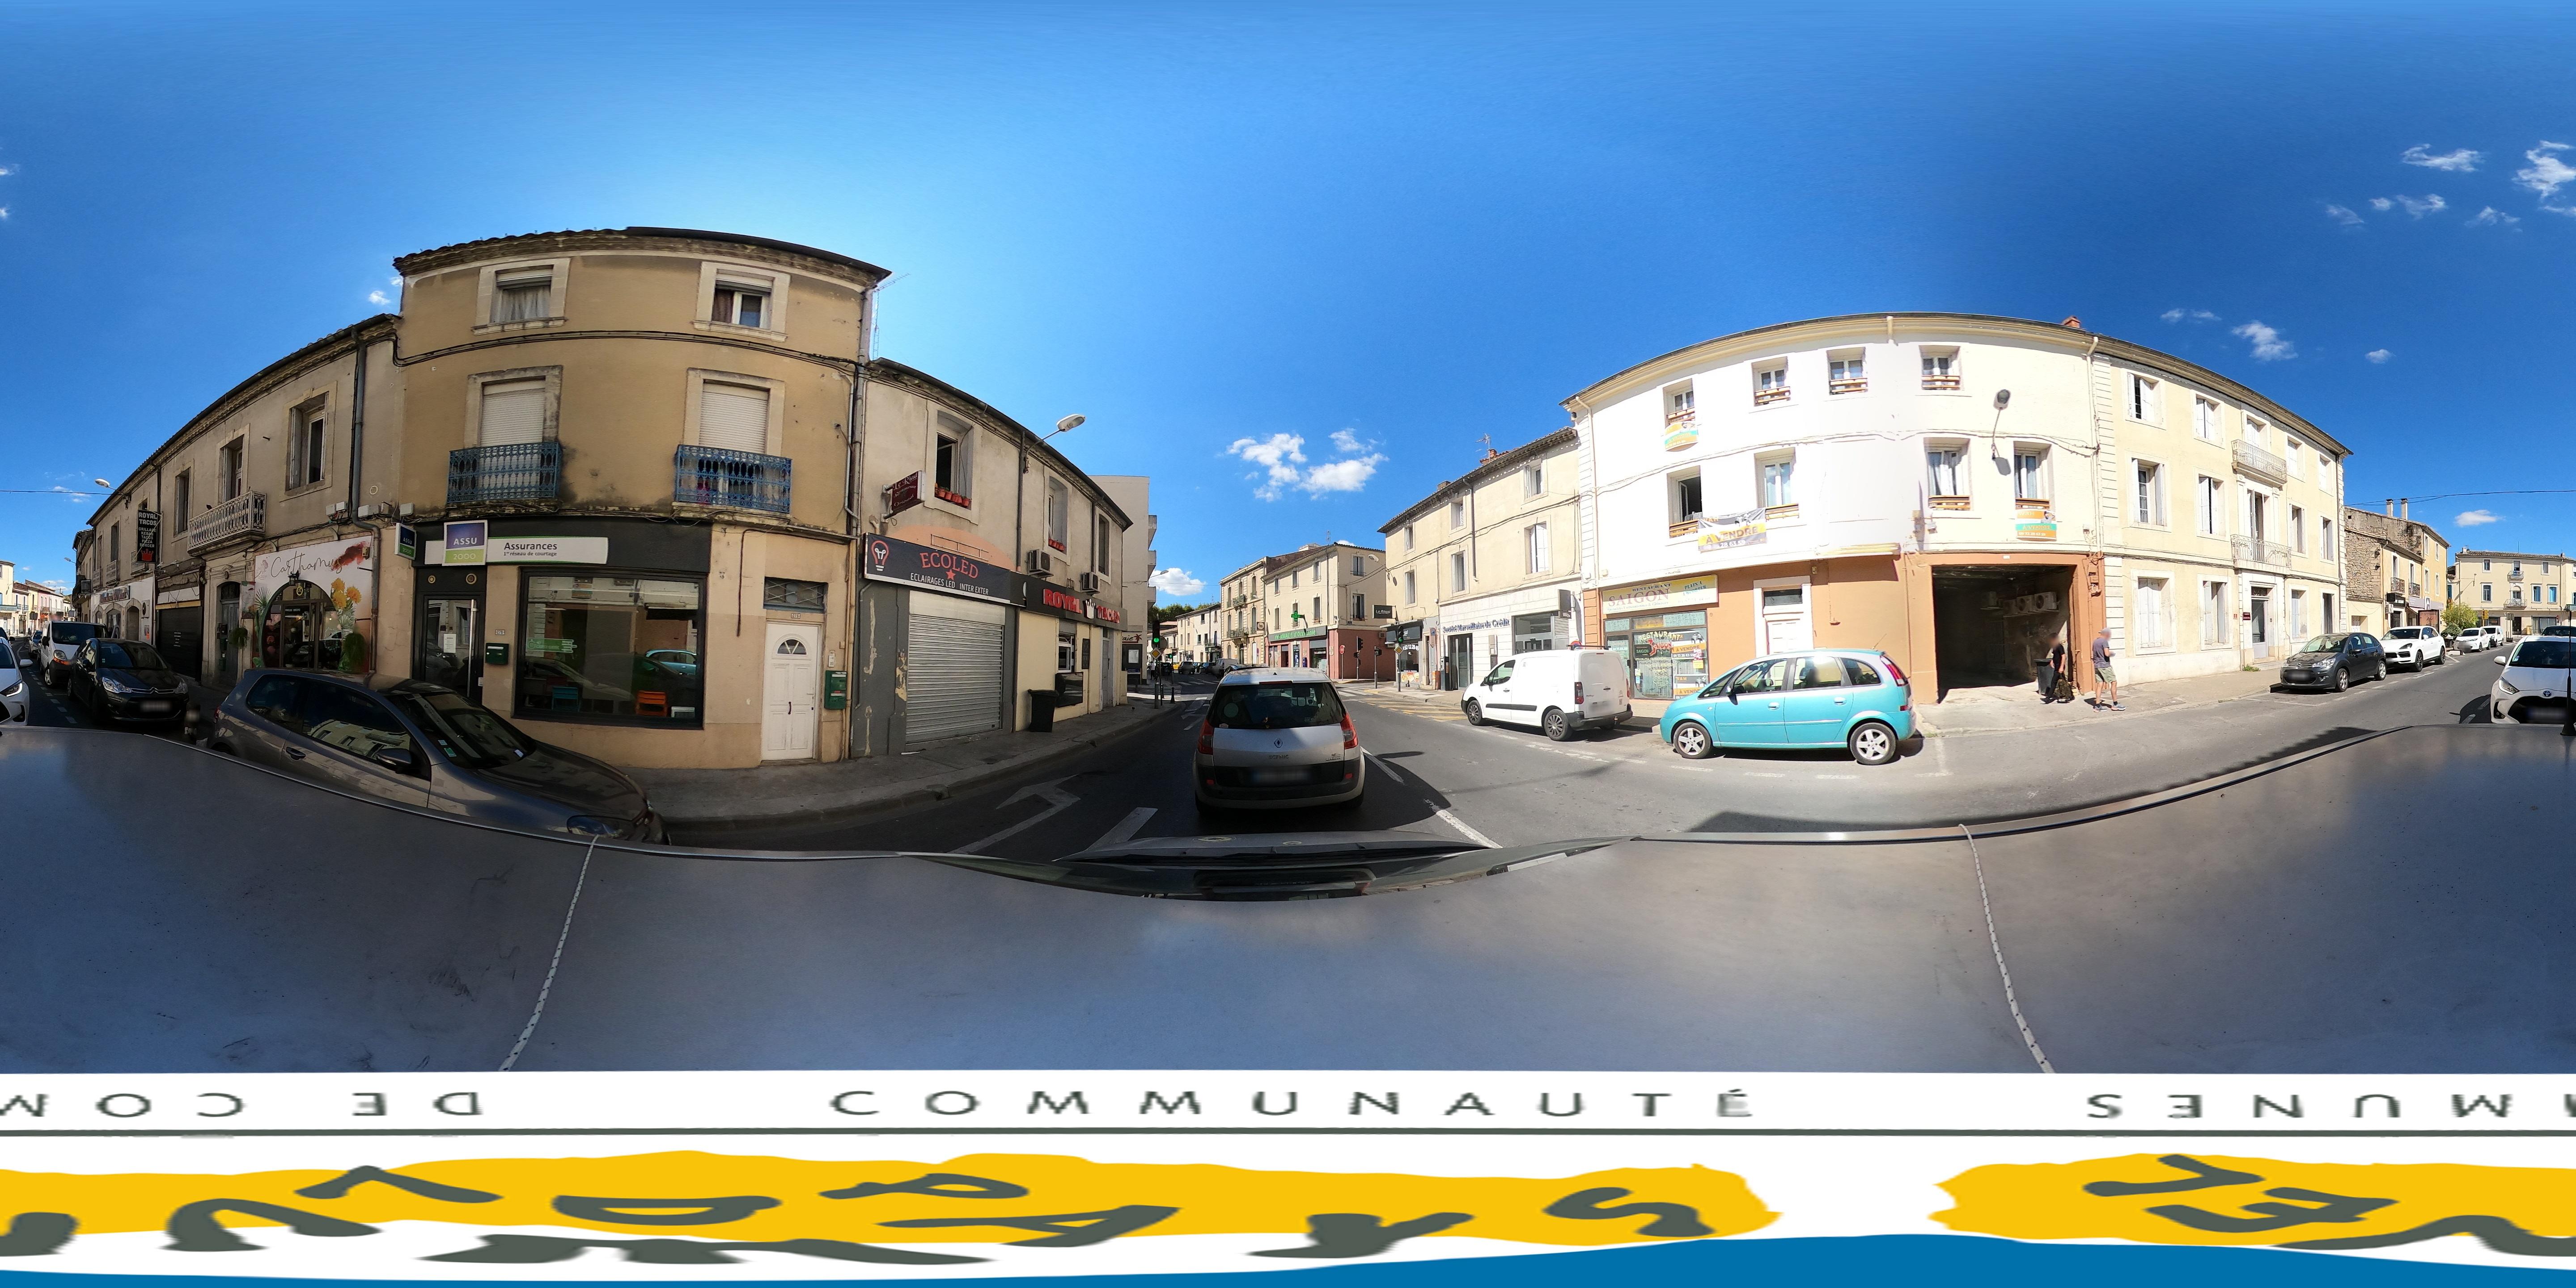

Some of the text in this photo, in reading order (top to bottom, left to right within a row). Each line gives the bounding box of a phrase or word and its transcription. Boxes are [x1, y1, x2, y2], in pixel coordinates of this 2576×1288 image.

[453, 537, 478, 545] ASSU
[1715, 526, 1758, 541] VENDRE
[919, 552, 979, 578] ECOLED
[911, 572, 989, 595] ECLAIRAGES LED INTER EXTER
[1632, 583, 1672, 592] RESTAURANT
[1043, 589, 1083, 614] ROYAL
[1608, 588, 1670, 606] SAIGON
[1485, 620, 1491, 628] de
[1492, 618, 1510, 627] Crédit
[1638, 631, 1681, 642] RESTAURANT
